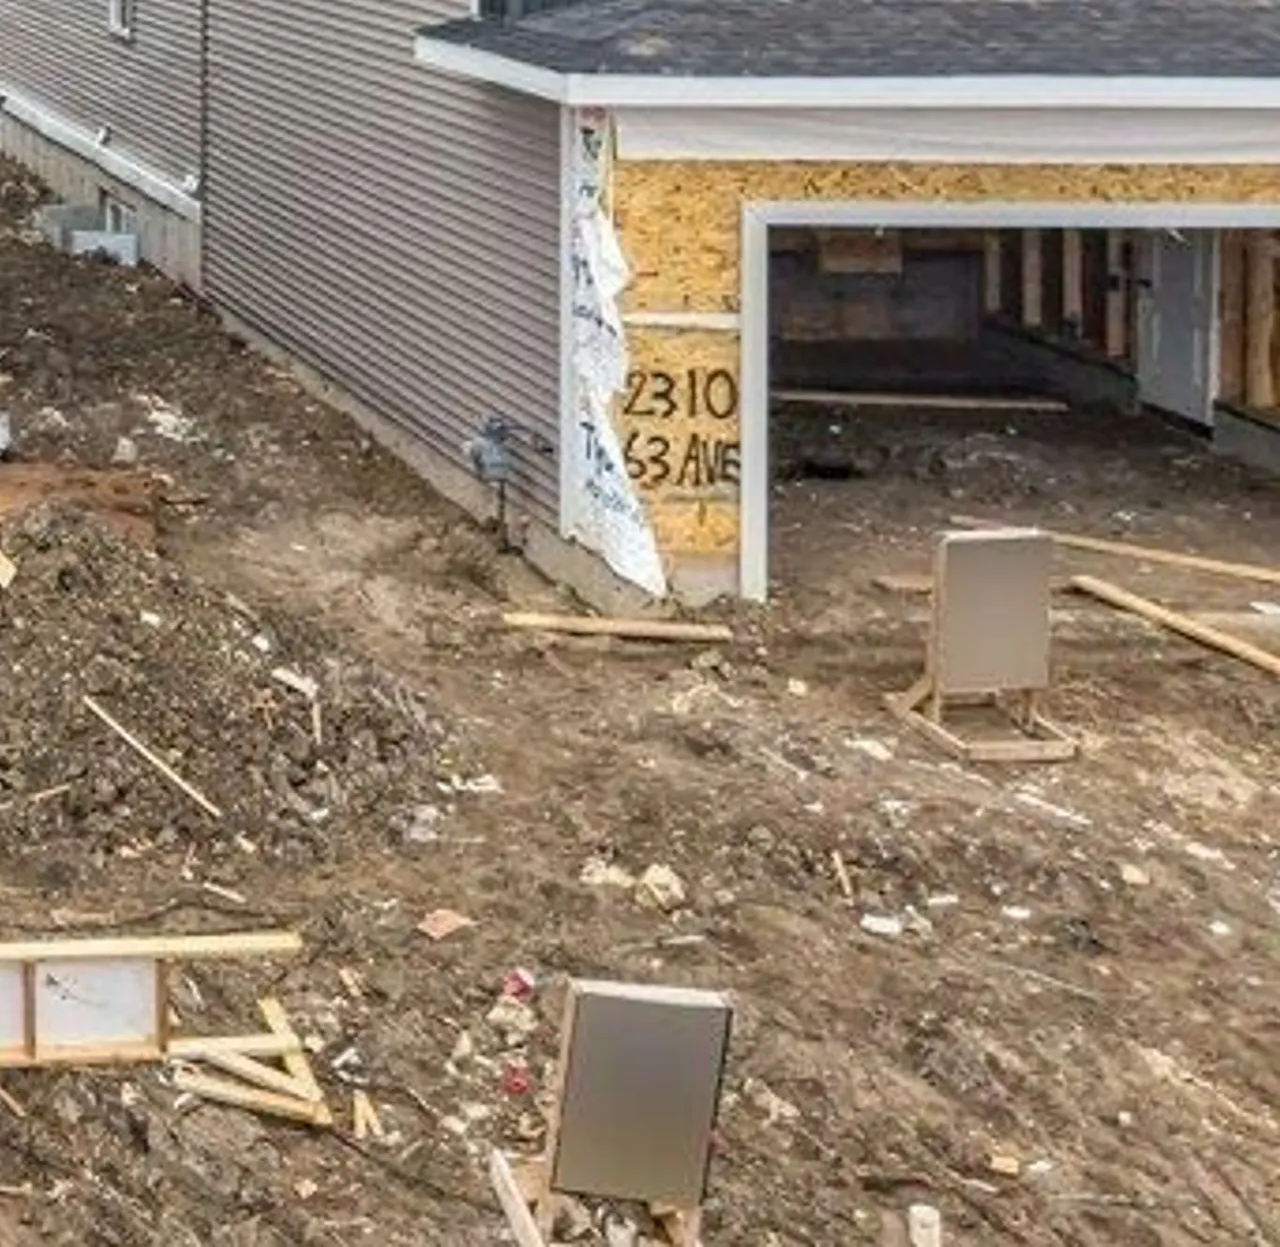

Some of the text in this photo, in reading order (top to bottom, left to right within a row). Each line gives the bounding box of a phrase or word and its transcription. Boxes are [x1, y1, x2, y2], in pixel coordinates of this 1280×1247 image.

[623, 368, 739, 419] 2310
[623, 431, 671, 483] 63
[676, 433, 741, 486] AVE
